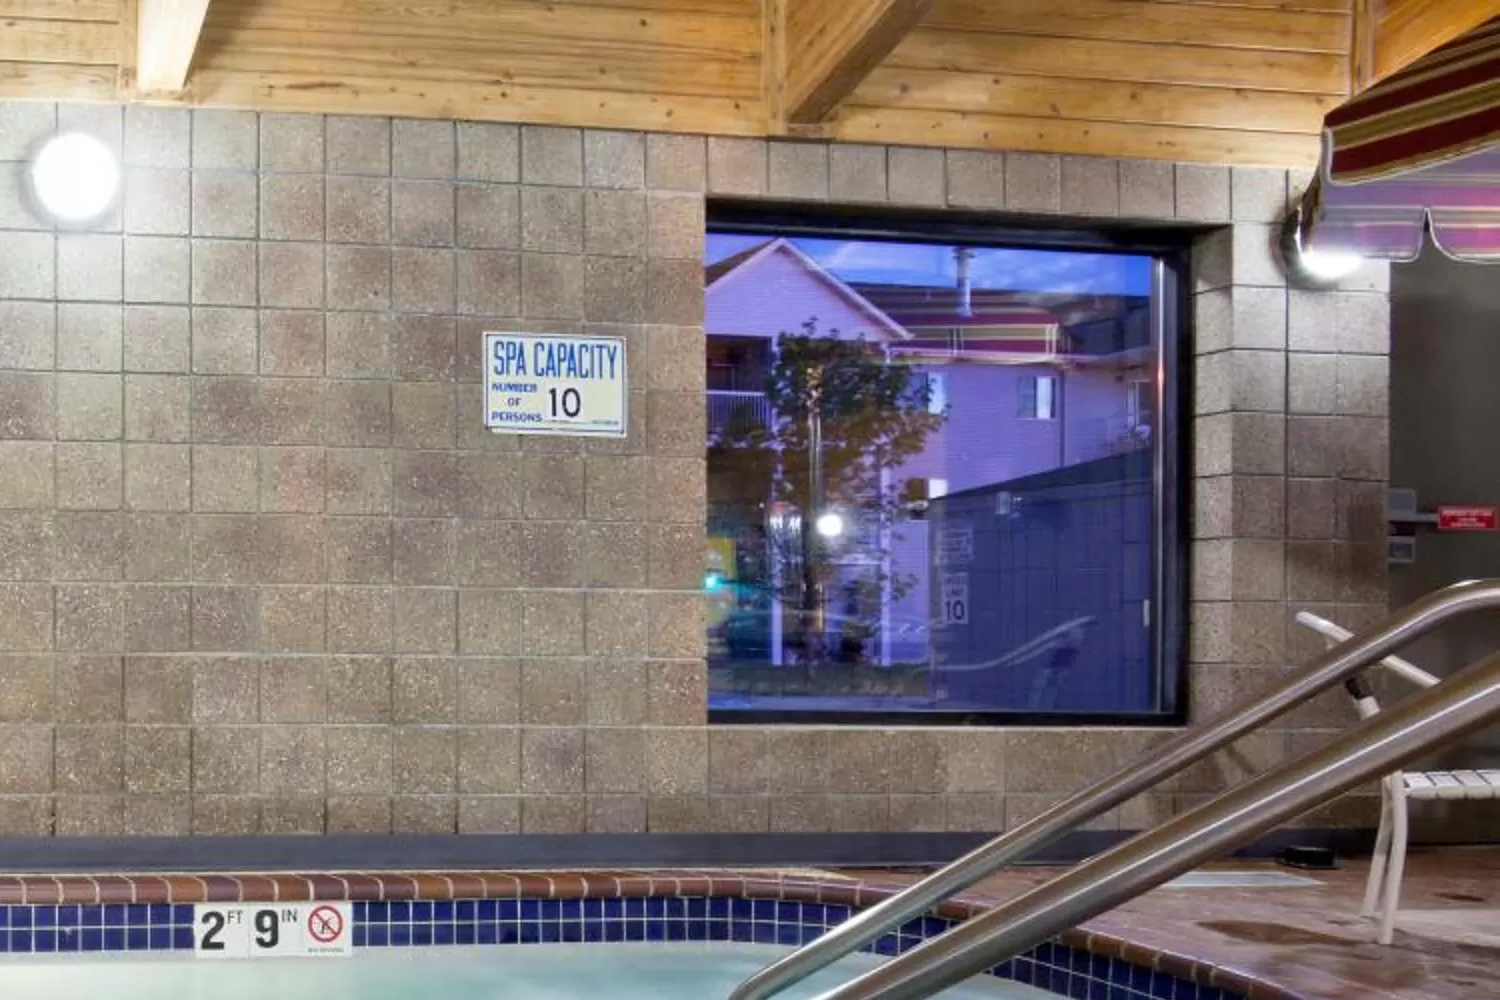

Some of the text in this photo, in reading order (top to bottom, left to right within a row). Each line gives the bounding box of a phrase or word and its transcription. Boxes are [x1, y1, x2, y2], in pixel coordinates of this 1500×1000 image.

[494, 341, 617, 380] SPA CAPACITY
[492, 383, 538, 393] NUMBER
[507, 397, 523, 407] OF
[548, 387, 581, 418] 10
[492, 411, 543, 422] PERSONS
[946, 600, 965, 621] 10
[201, 909, 298, 950] 2 FT 9 IN
